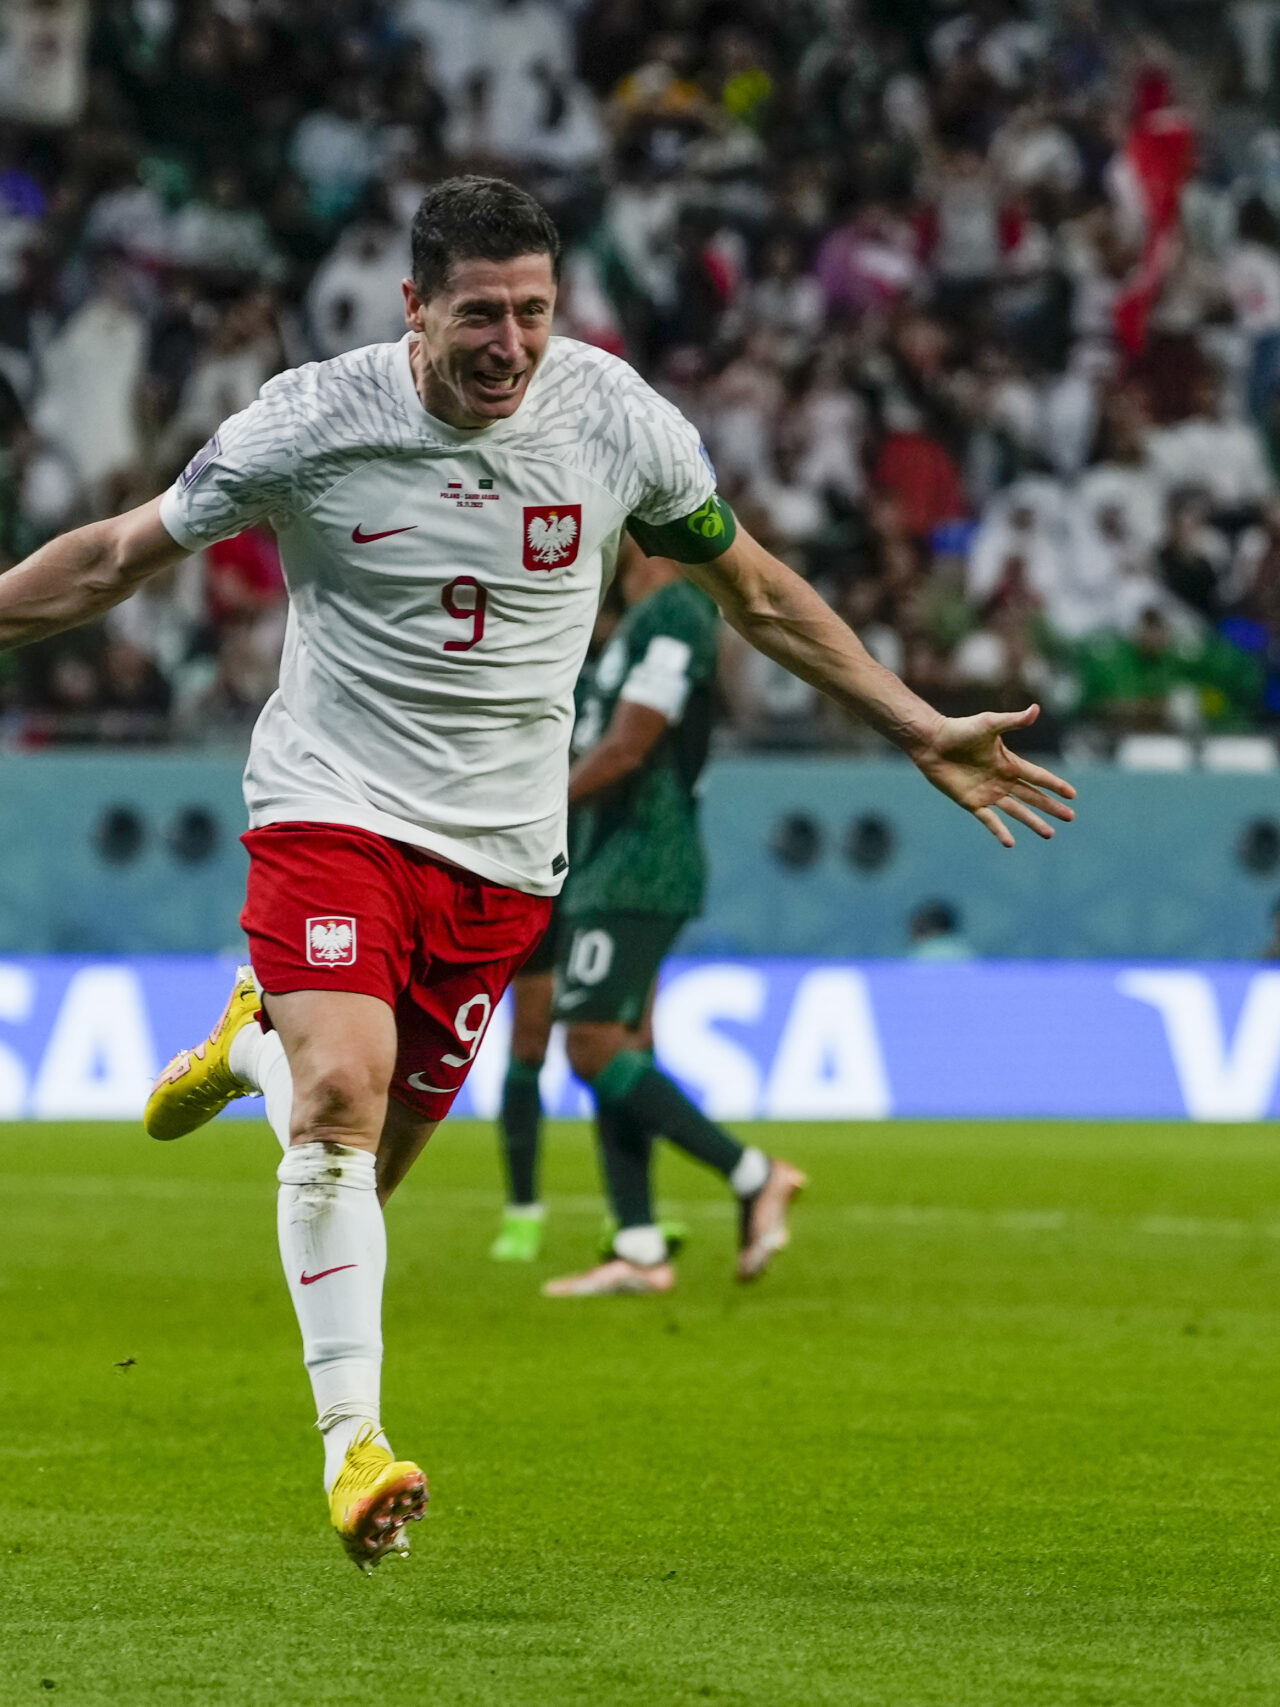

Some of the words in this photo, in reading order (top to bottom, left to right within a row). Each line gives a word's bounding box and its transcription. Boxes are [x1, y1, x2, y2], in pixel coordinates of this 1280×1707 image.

[441, 575, 488, 651] 9
[566, 928, 615, 985] 10
[440, 993, 491, 1068] 9
